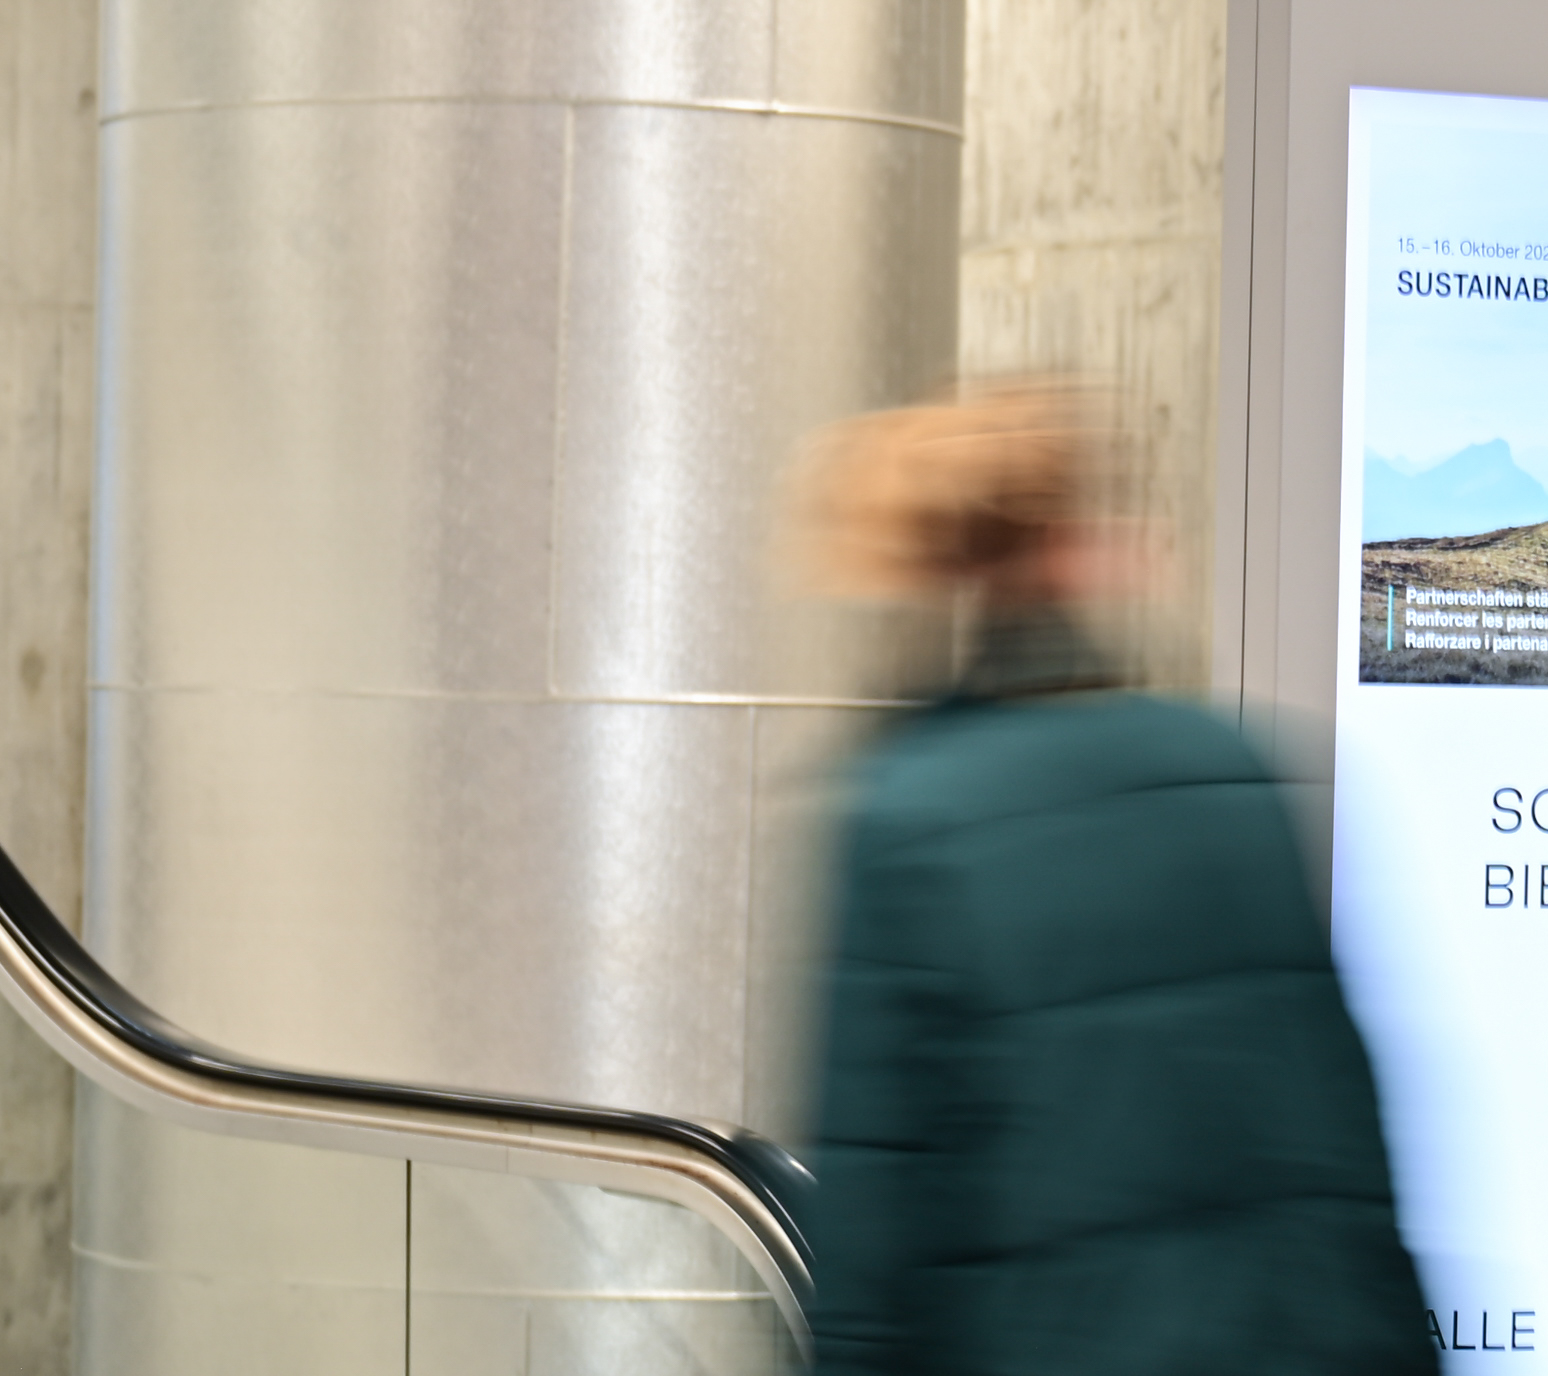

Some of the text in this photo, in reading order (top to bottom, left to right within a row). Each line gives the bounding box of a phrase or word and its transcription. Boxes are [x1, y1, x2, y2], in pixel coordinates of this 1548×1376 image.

[1459, 240, 1520, 259] Oktober
[1406, 585, 1523, 607] Partnerschaften
[1406, 608, 1479, 627] Renforcer
[1482, 610, 1503, 628] les
[1405, 630, 1481, 649] Rafforzare
[1425, 1308, 1536, 1351] ALLE
